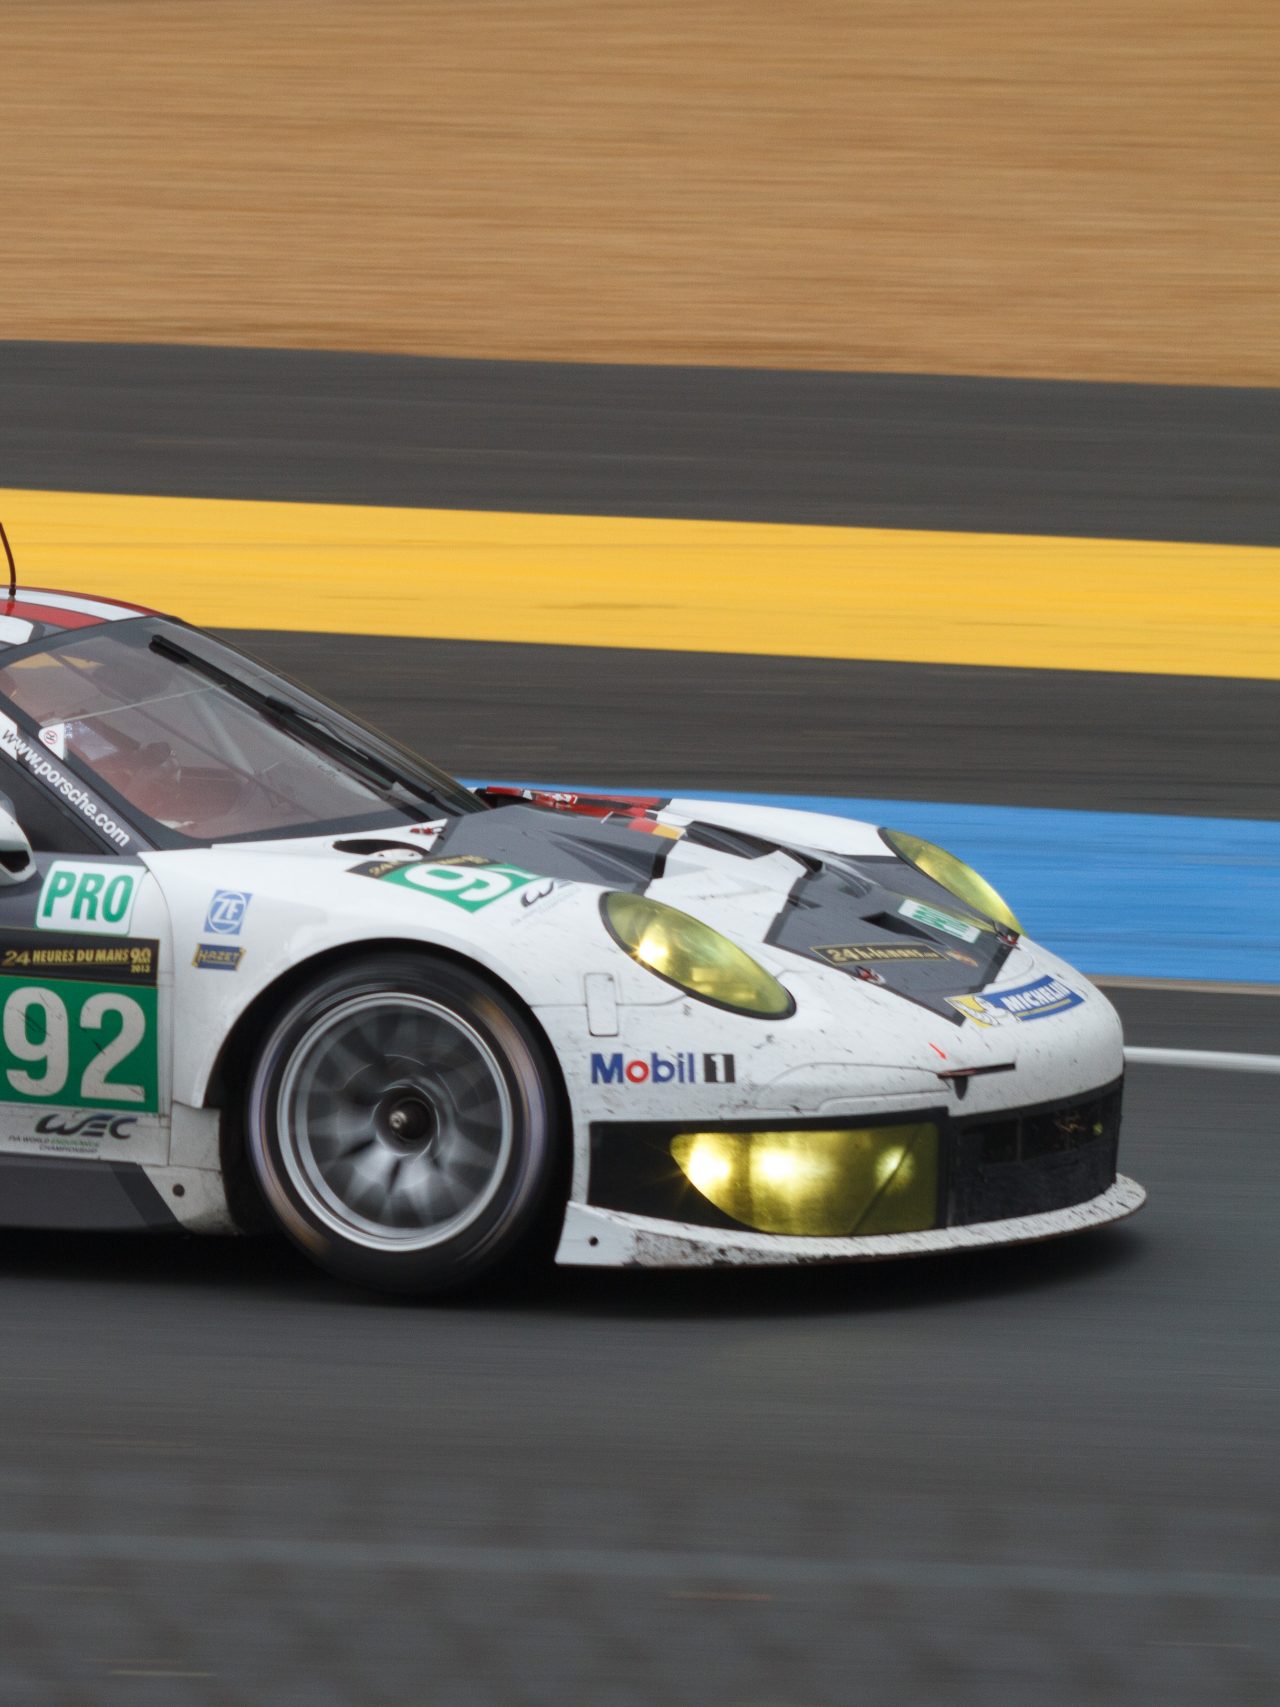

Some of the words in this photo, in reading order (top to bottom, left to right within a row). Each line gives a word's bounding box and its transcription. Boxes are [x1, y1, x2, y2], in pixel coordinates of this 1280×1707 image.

[2, 729, 131, 847] www.porsche.com
[42, 871, 134, 923] PRO
[211, 898, 243, 925] ZF
[2, 950, 31, 966] 24
[33, 949, 74, 963] HEURES
[76, 949, 94, 963] DU
[95, 948, 129, 963] MANS
[1000, 979, 1071, 1012] MICHELIN
[3, 986, 146, 1102] 92
[590, 1053, 696, 1084] Mobil
[35, 1113, 137, 1140] WEC
